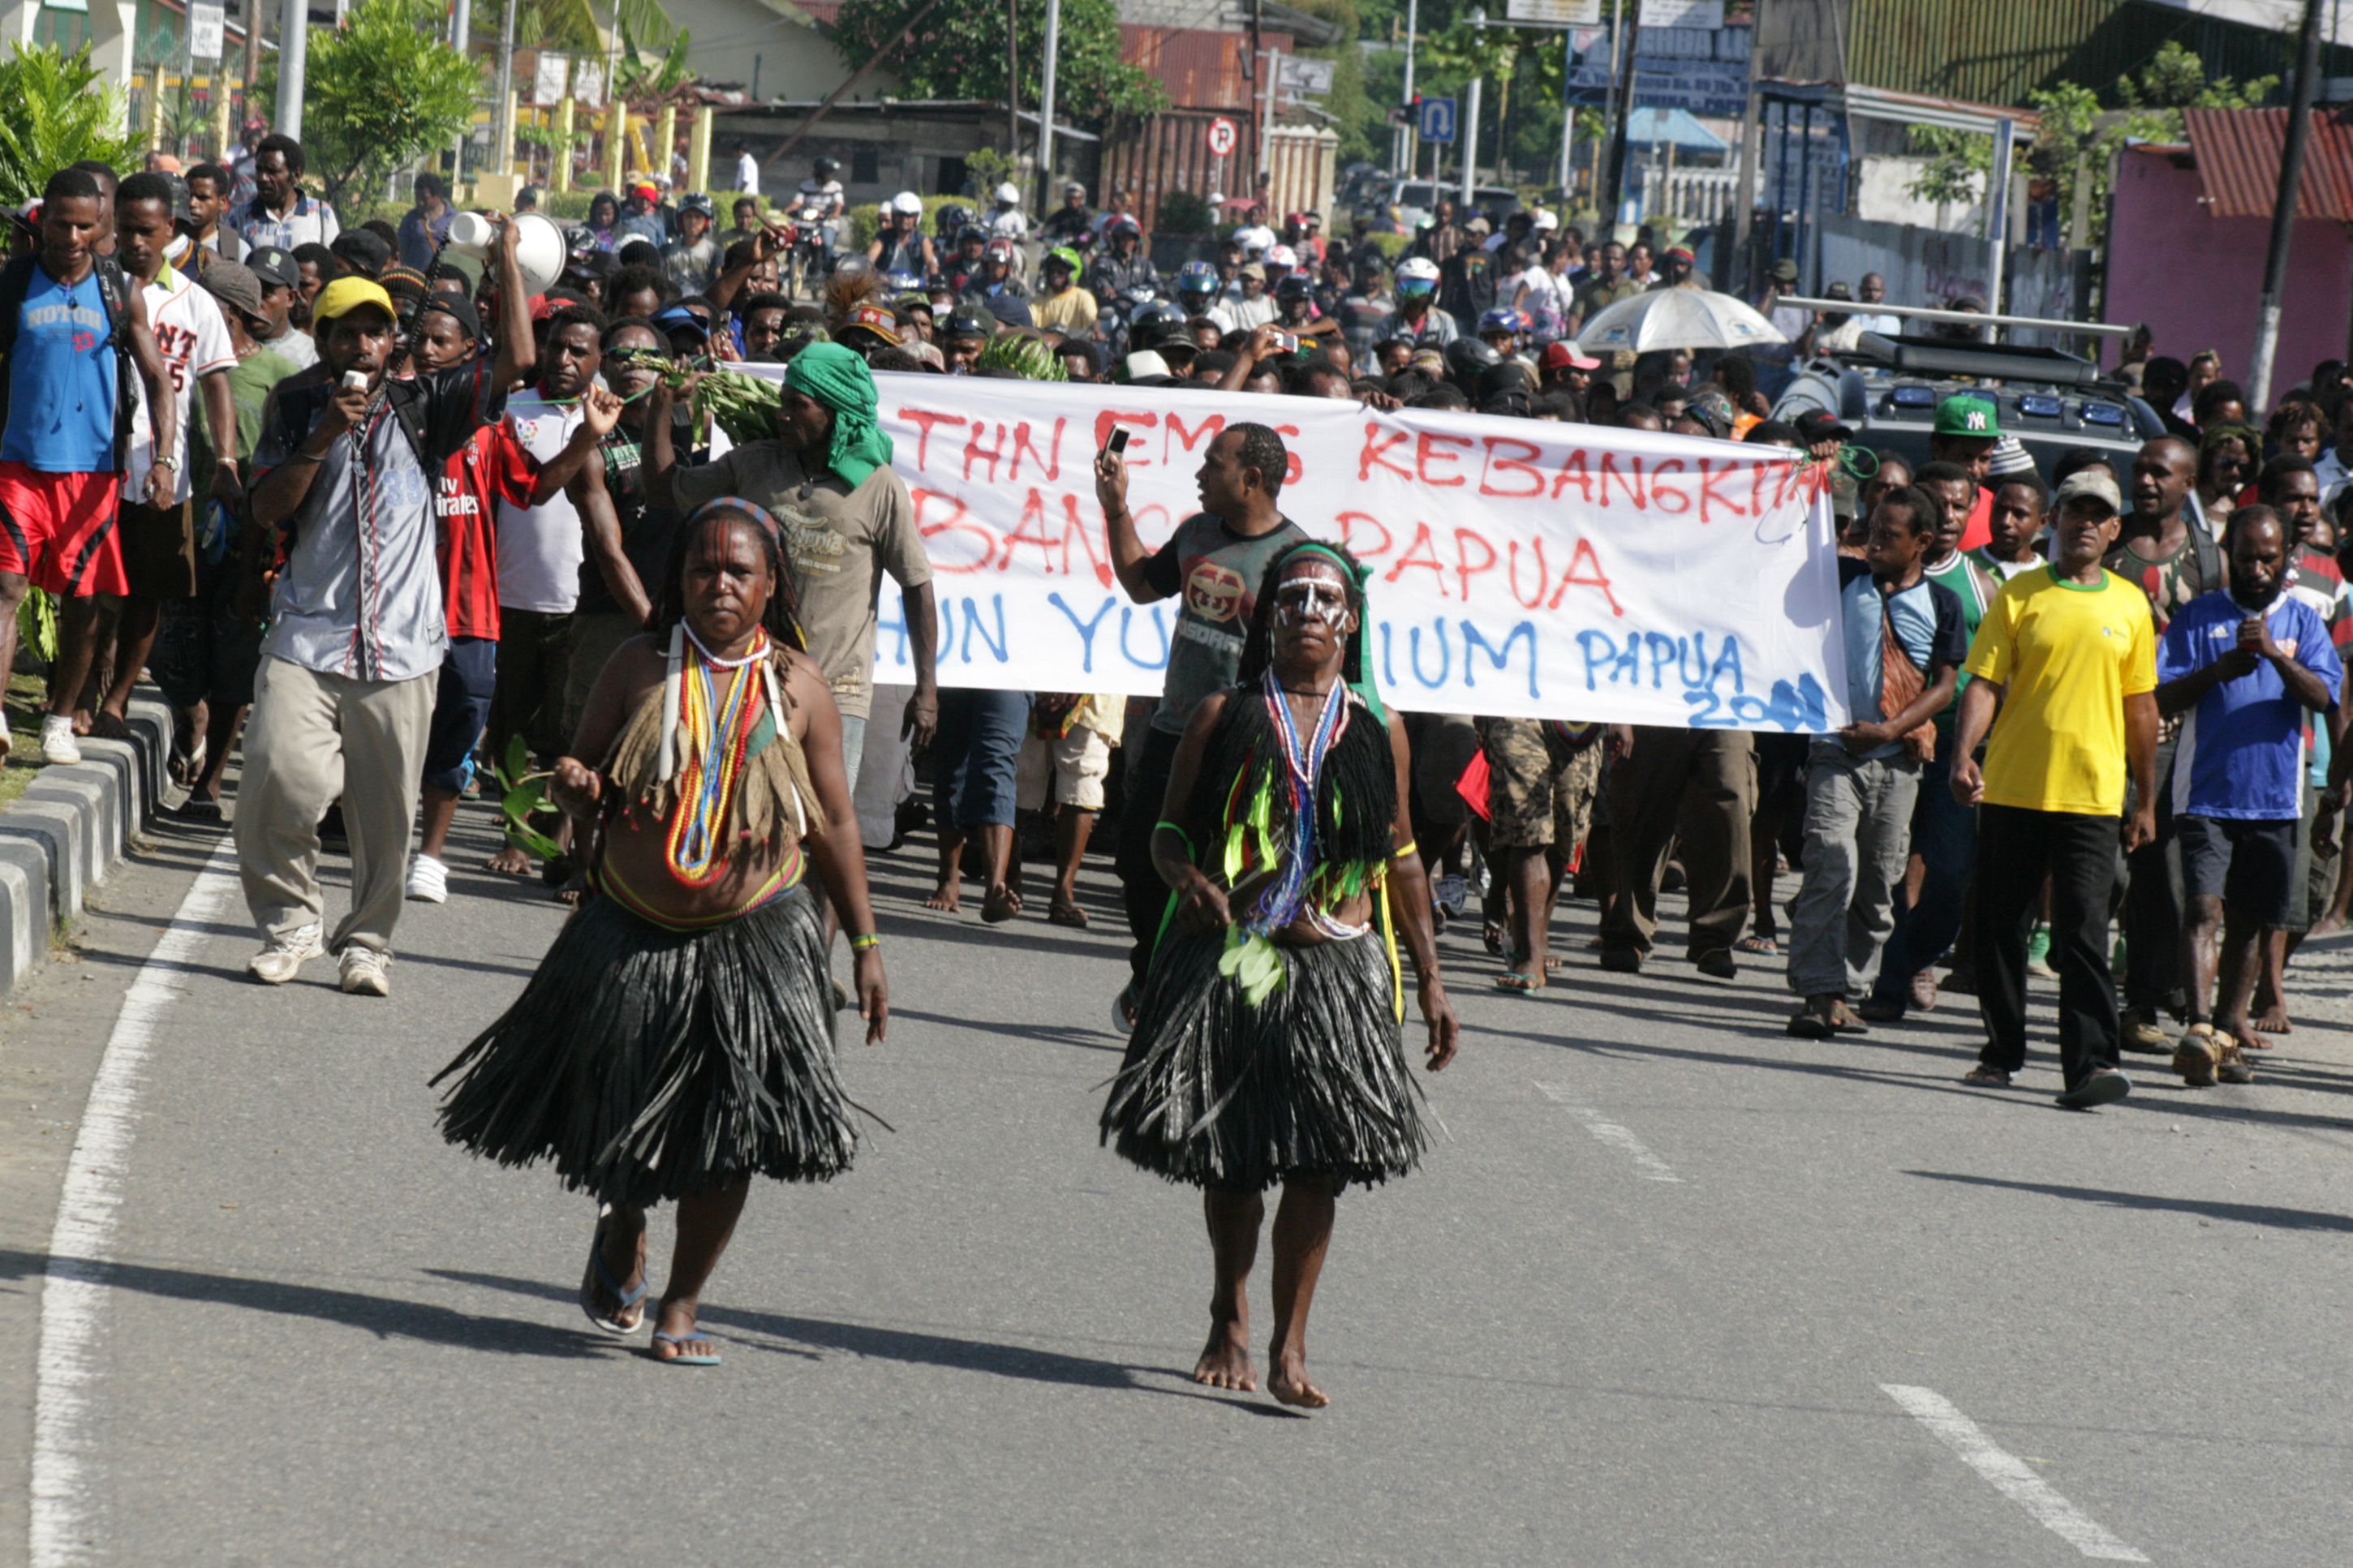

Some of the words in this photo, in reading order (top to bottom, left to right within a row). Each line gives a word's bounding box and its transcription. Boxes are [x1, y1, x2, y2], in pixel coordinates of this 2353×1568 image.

[156, 321, 197, 362] NT
[441, 476, 458, 495] ly
[897, 407, 1066, 483] THN
[1095, 410, 1301, 485] EMS
[1357, 422, 1831, 523] KEBANGKITA
[435, 492, 480, 517] irates
[1335, 511, 1624, 617] PAPUA
[1576, 630, 1744, 693] PAPUA
